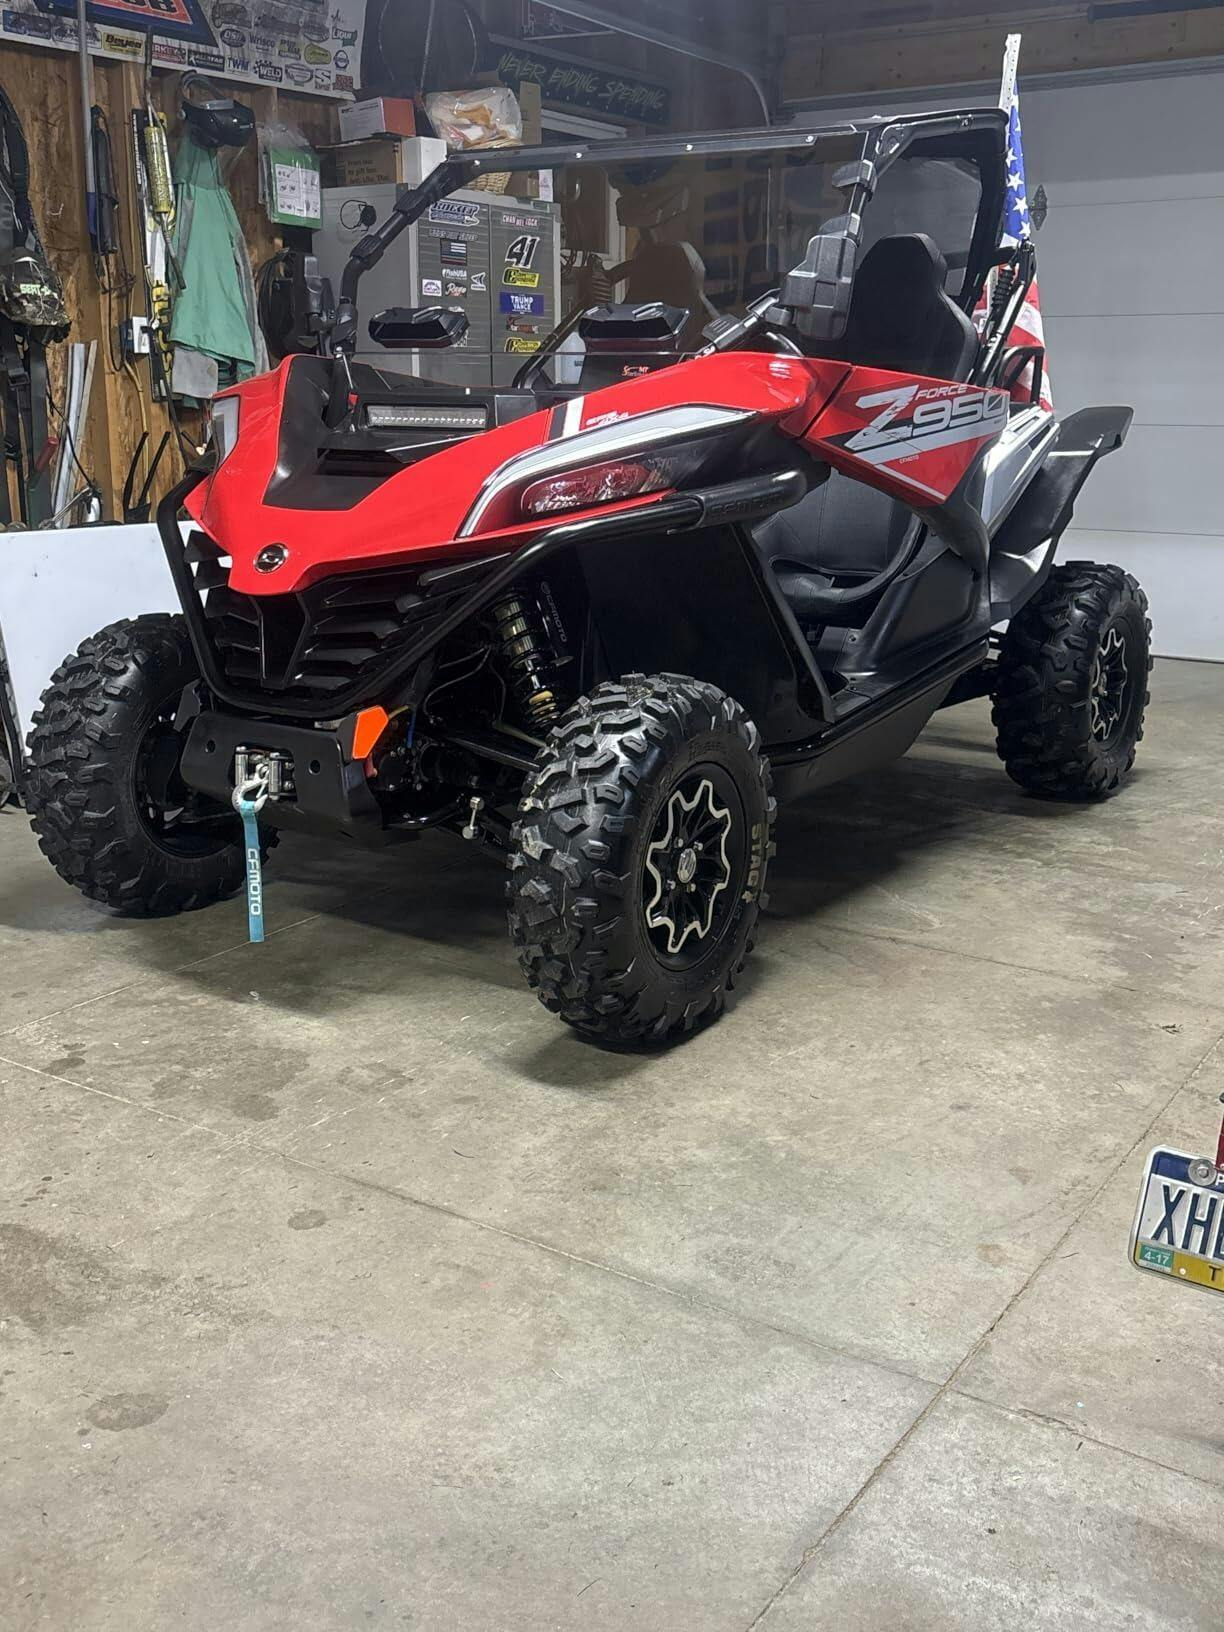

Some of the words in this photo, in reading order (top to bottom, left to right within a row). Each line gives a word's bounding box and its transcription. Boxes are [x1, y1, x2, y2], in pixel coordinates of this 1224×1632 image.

[259, 65, 282, 78] WELD
[498, 52, 548, 82] NEVER
[548, 67, 600, 94] ENDING
[598, 81, 667, 110] SPENDING
[504, 235, 541, 270] 41
[510, 295, 534, 305] TRUMP
[513, 303, 532, 311] VANCE
[914, 384, 968, 401] FORCE
[912, 392, 1008, 438] 950
[247, 848, 262, 916] CFMOTO
[1143, 1251, 1170, 1266] 4-17
